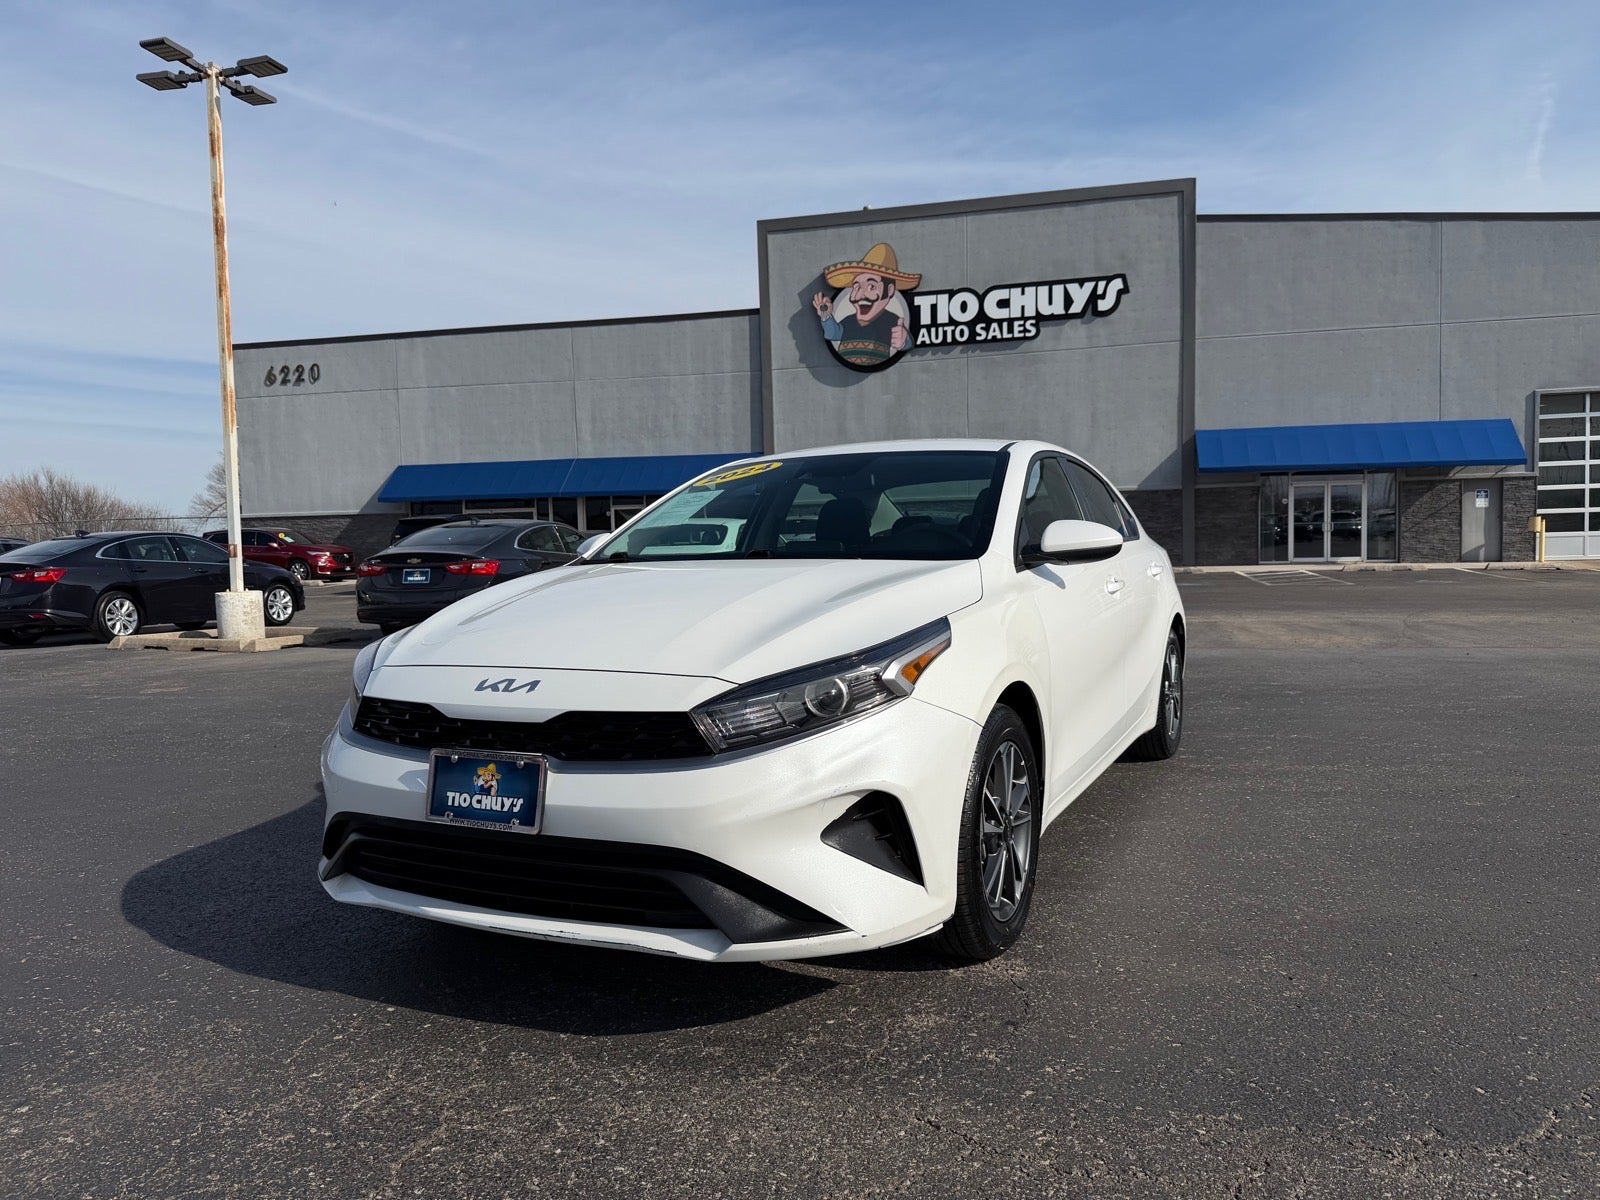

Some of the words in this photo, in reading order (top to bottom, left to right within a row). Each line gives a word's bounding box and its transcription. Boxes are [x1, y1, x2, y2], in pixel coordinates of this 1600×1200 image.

[914, 291, 980, 326] TIO
[983, 277, 1125, 320] CHUY'S
[916, 324, 970, 345] AUTO
[975, 319, 1038, 341] SALES
[263, 363, 320, 387] 6220
[474, 678, 542, 693] KIA
[446, 791, 471, 808] TIO
[471, 794, 524, 812] CHUY'S
